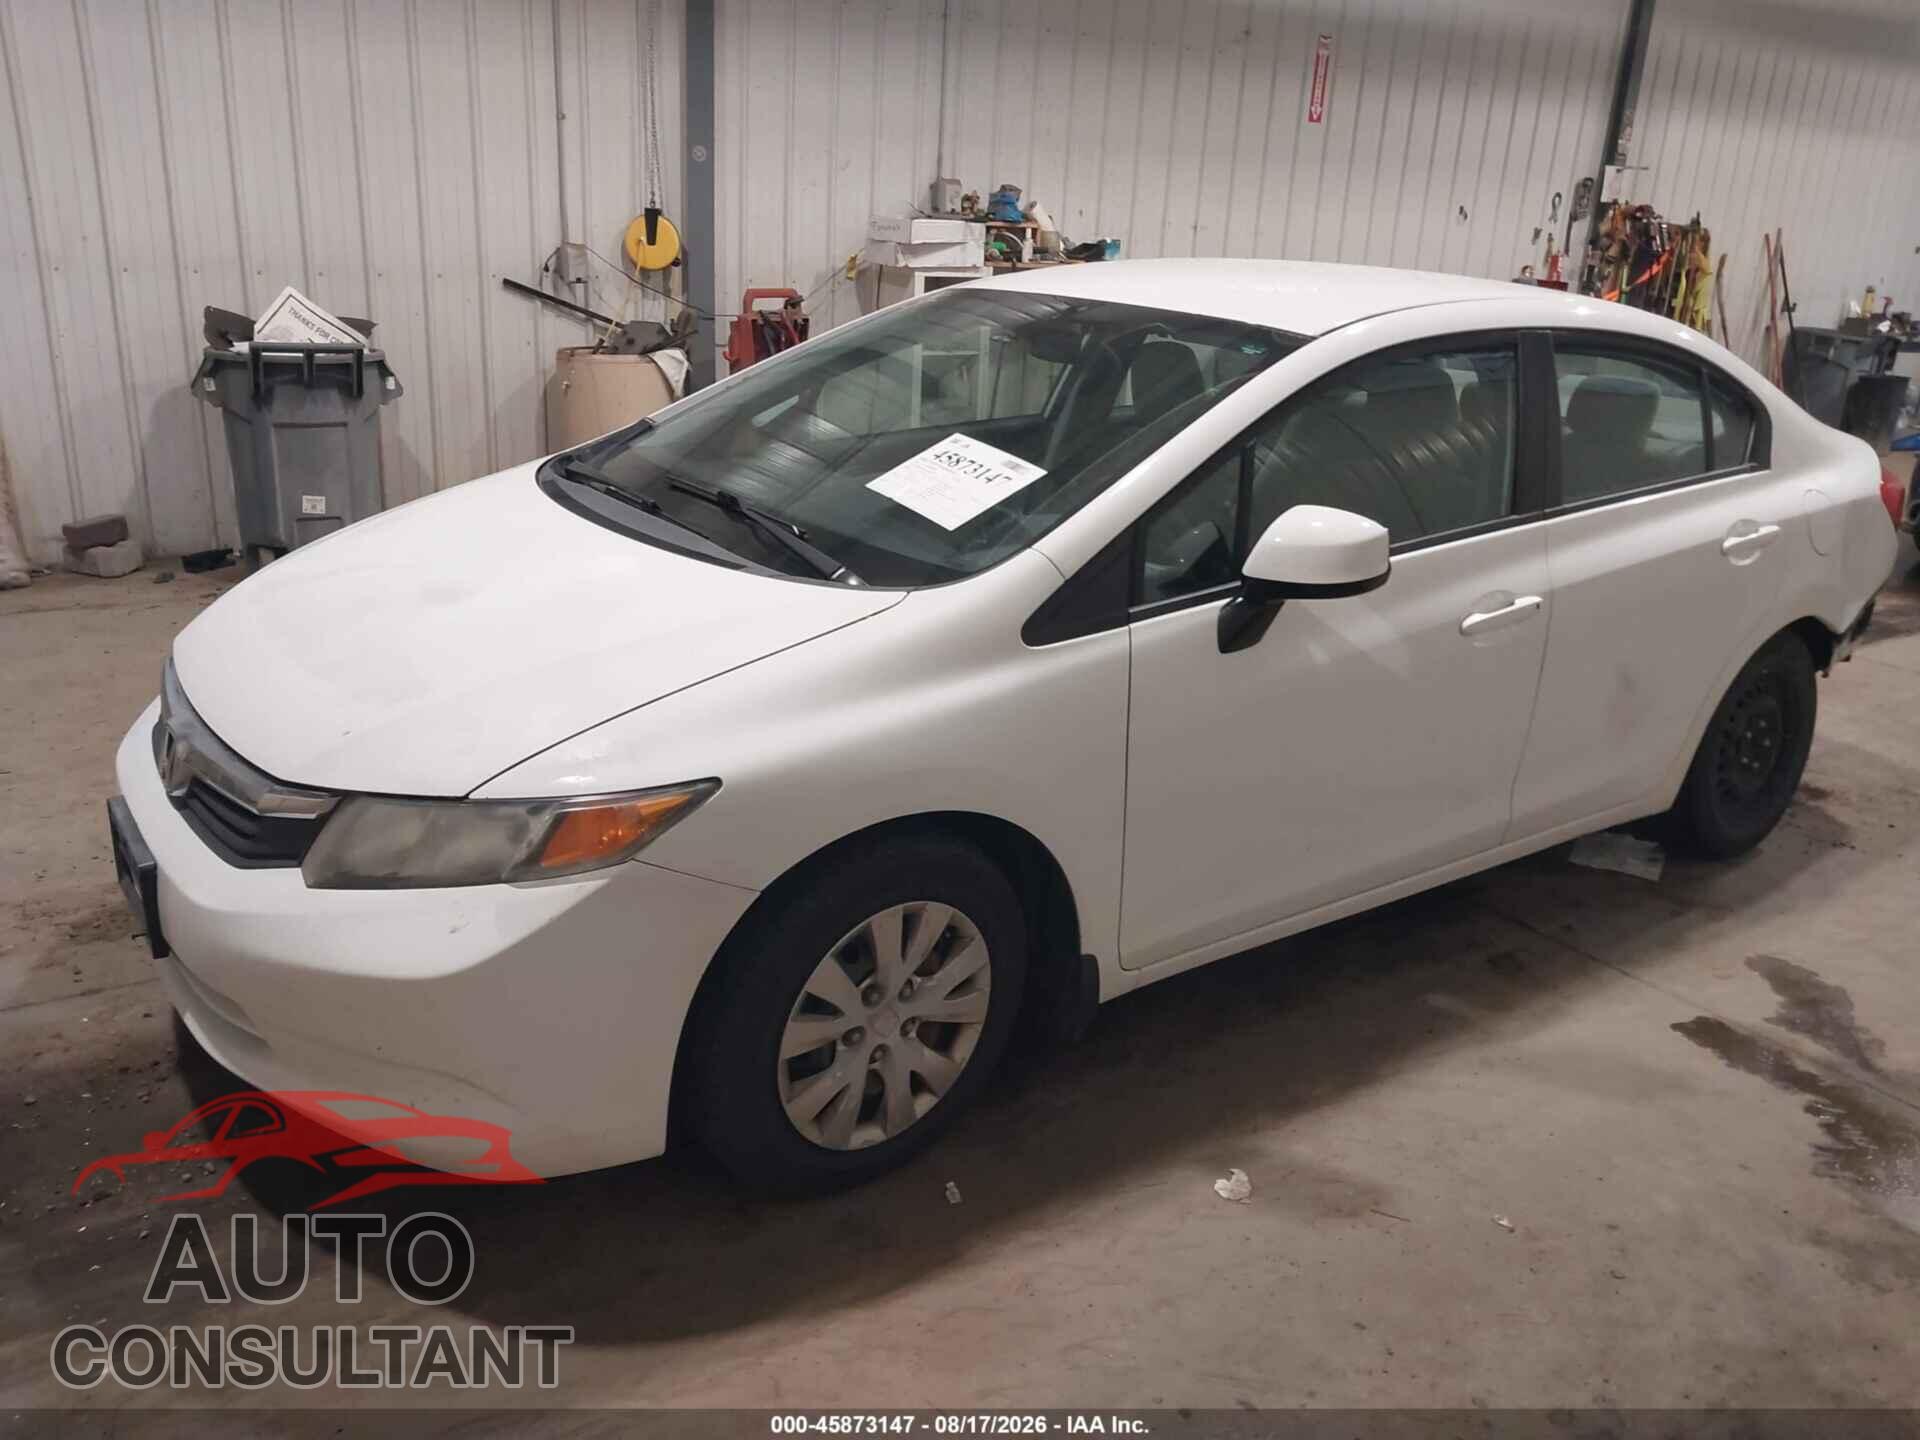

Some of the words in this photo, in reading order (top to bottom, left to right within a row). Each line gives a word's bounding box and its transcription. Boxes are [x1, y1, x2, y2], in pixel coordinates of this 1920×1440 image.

[288, 306, 316, 330] THANKS
[315, 326, 330, 340] FOR
[932, 450, 1013, 485] 45873147
